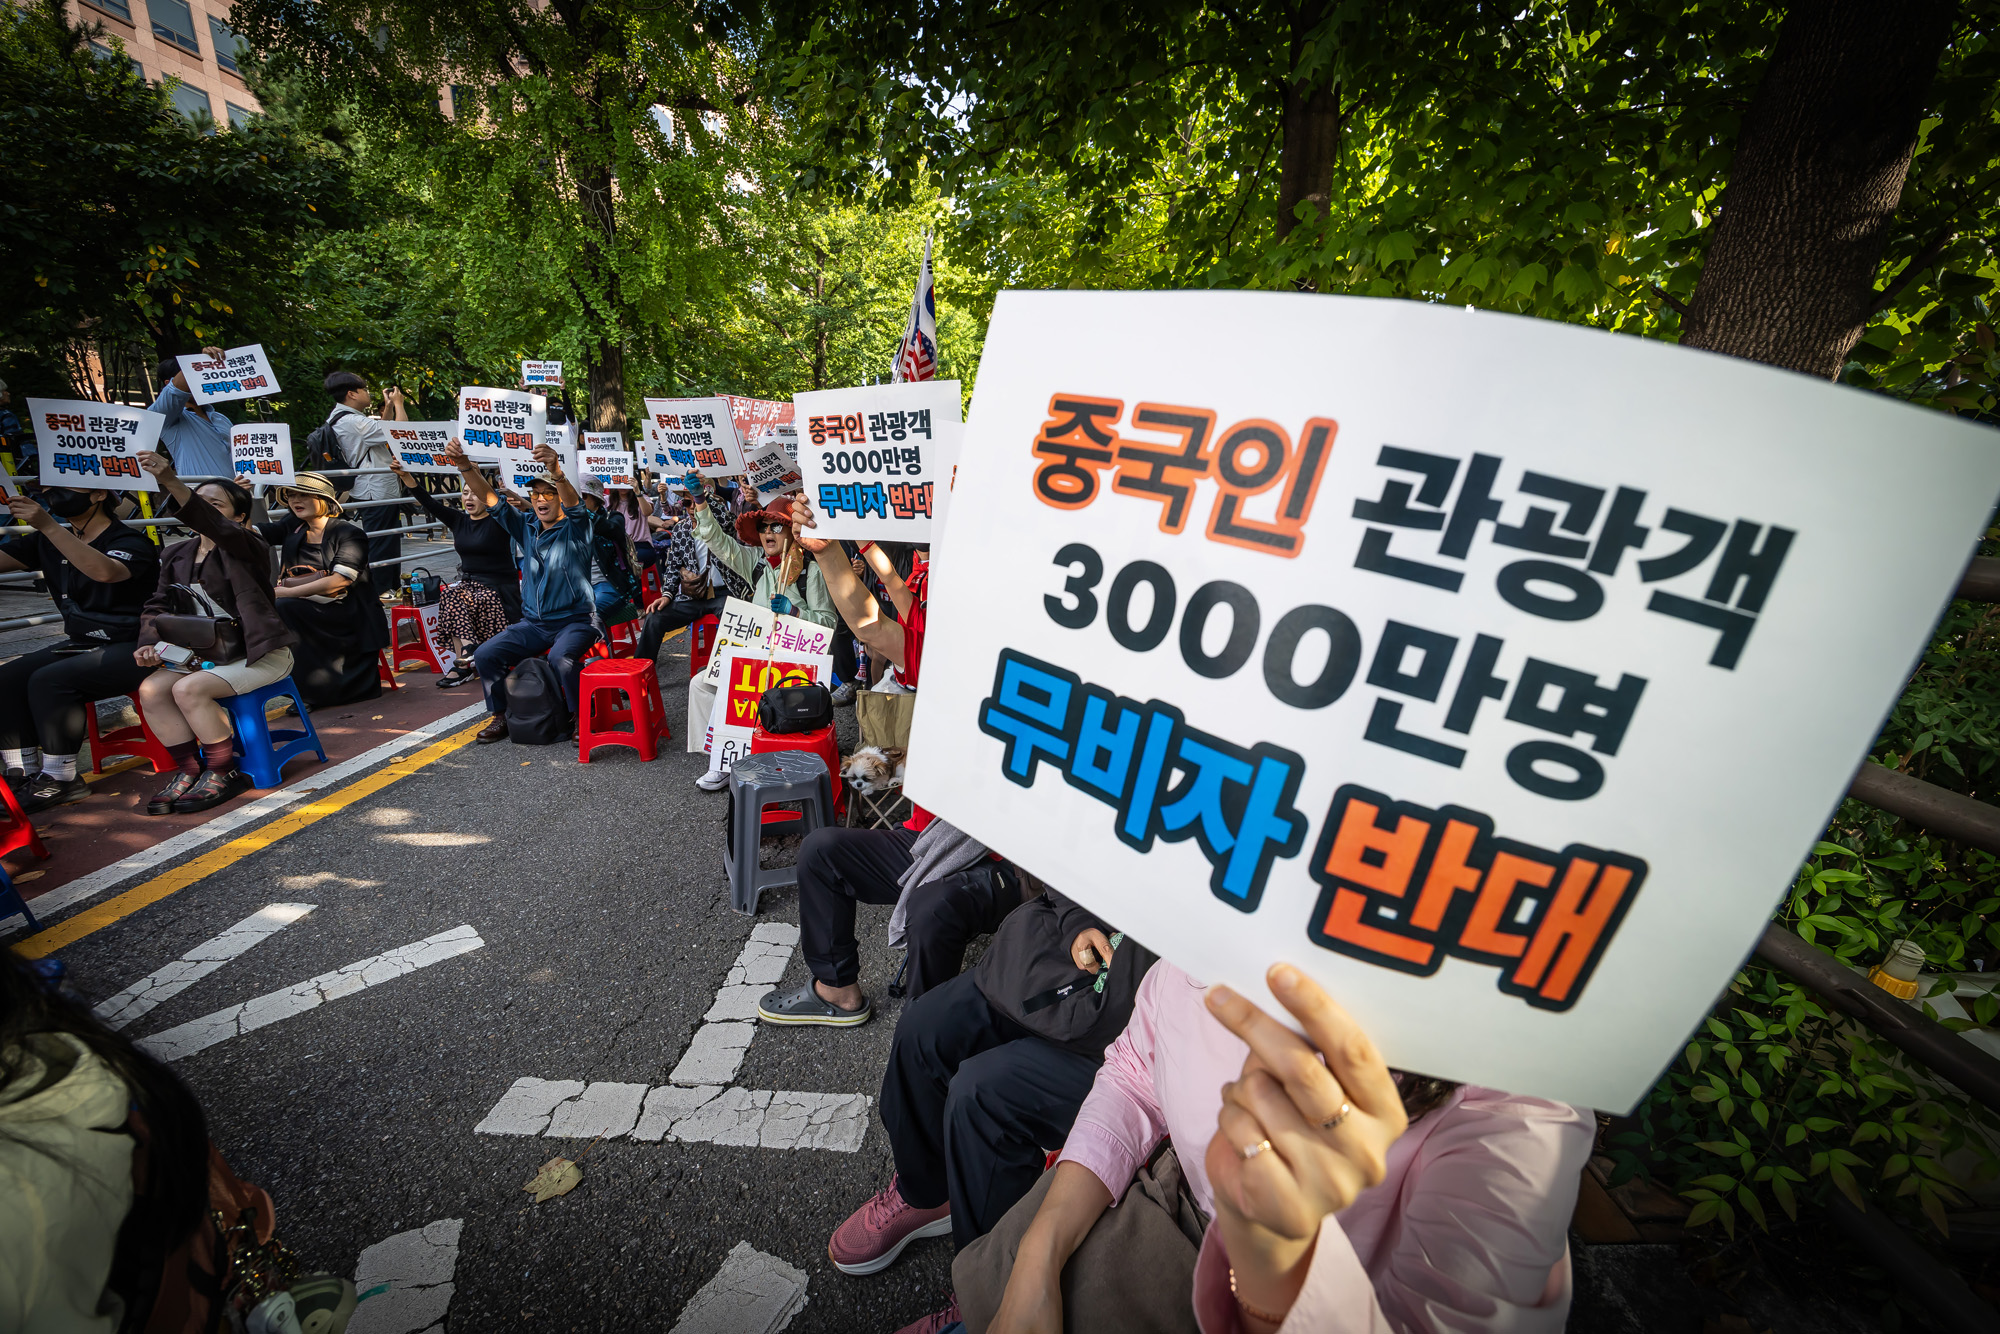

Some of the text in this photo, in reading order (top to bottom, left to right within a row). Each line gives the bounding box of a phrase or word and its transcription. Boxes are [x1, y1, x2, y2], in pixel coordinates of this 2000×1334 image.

[191, 353, 257, 372] 중국인 관광객
[202, 365, 256, 381] 3000만명
[201, 374, 268, 395] 무비자 반대
[464, 397, 532, 416] 중국인 관광객
[732, 397, 753, 420] 중국인
[45, 413, 139, 435] 중국인 관광객
[467, 413, 525, 430] 3000만명
[656, 413, 715, 430] 중국인 관광객
[808, 412, 866, 446] 중국인
[868, 408, 932, 441] 관광객
[57, 434, 126, 453] 3000만명
[250, 433, 278, 445] 관광객
[390, 429, 448, 441] 중국인 관광객
[463, 428, 534, 450] 무비자 반대
[665, 431, 713, 446] 3000만명
[399, 442, 445, 452] 3000만명
[53, 452, 142, 479] 무비자 반대
[256, 459, 283, 475] 반대
[400, 452, 433, 466] 무비자
[586, 457, 606, 465] 중국인
[694, 448, 727, 467] 반대
[756, 452, 781, 468] 관광객
[821, 445, 922, 475] 3000만명
[750, 464, 787, 484] 3000만명
[756, 478, 787, 494] 무비자
[817, 481, 934, 520] 무비자 반대
[1030, 391, 1798, 672] 중국인 관광객
[1042, 541, 1650, 802] 3000만명
[978, 646, 1650, 1013] 무비자 반대
